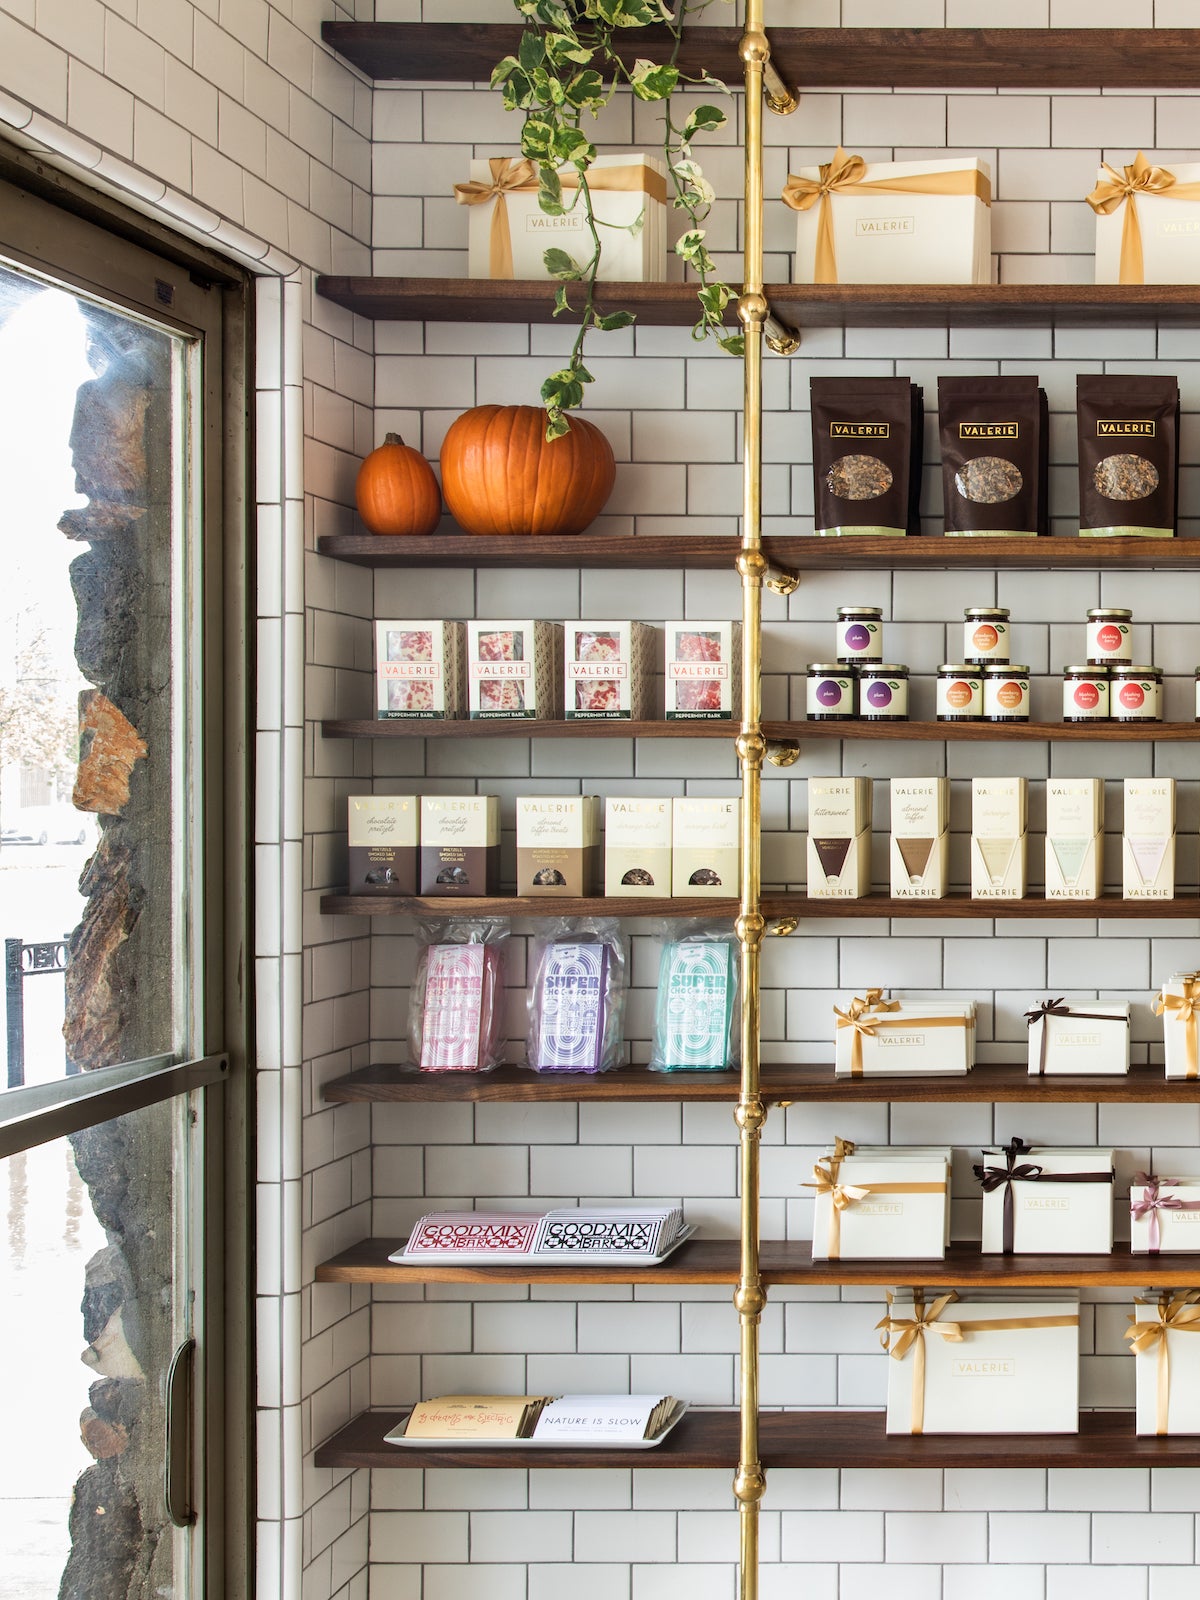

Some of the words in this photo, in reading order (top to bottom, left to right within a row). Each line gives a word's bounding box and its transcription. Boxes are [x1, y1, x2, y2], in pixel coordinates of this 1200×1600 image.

[531, 217, 578, 227] VALERIE
[861, 220, 909, 232] VALERIE
[835, 425, 886, 436] VALERIE
[964, 426, 1014, 436] VALERIE
[1101, 424, 1151, 434] VALERIE
[385, 667, 435, 675] VALERIE
[477, 666, 527, 675] VALERIE
[573, 667, 623, 675] VALERIE
[674, 667, 724, 675] VALERIE
[813, 787, 851, 795] VALERIE
[1129, 788, 1167, 796] VALERIE
[354, 802, 409, 811] VALERIE
[427, 802, 481, 811] VALERIE
[524, 804, 575, 813] VALERIE
[611, 804, 665, 813] VALERIE
[814, 808, 849, 817] bittersweet
[366, 816, 397, 825] chocolate
[438, 816, 468, 825] chocolate
[813, 888, 854, 896] VALERIE
[1128, 889, 1168, 897] VALERIE
[427, 975, 481, 988] SUPER
[545, 975, 600, 988] SUPER
[671, 975, 726, 988] SUPER
[882, 1036, 921, 1045] VALERIE
[1059, 1035, 1097, 1043] VALERIE
[1027, 1199, 1067, 1208] VALERIE
[861, 1205, 899, 1213] VALERIE
[456, 1238, 486, 1248] BAR
[581, 1238, 612, 1248] BAR
[959, 1362, 1009, 1373] VALERIE
[544, 1417, 588, 1426] NATURE
[593, 1417, 604, 1426] IS
[607, 1417, 642, 1426] SLOW
